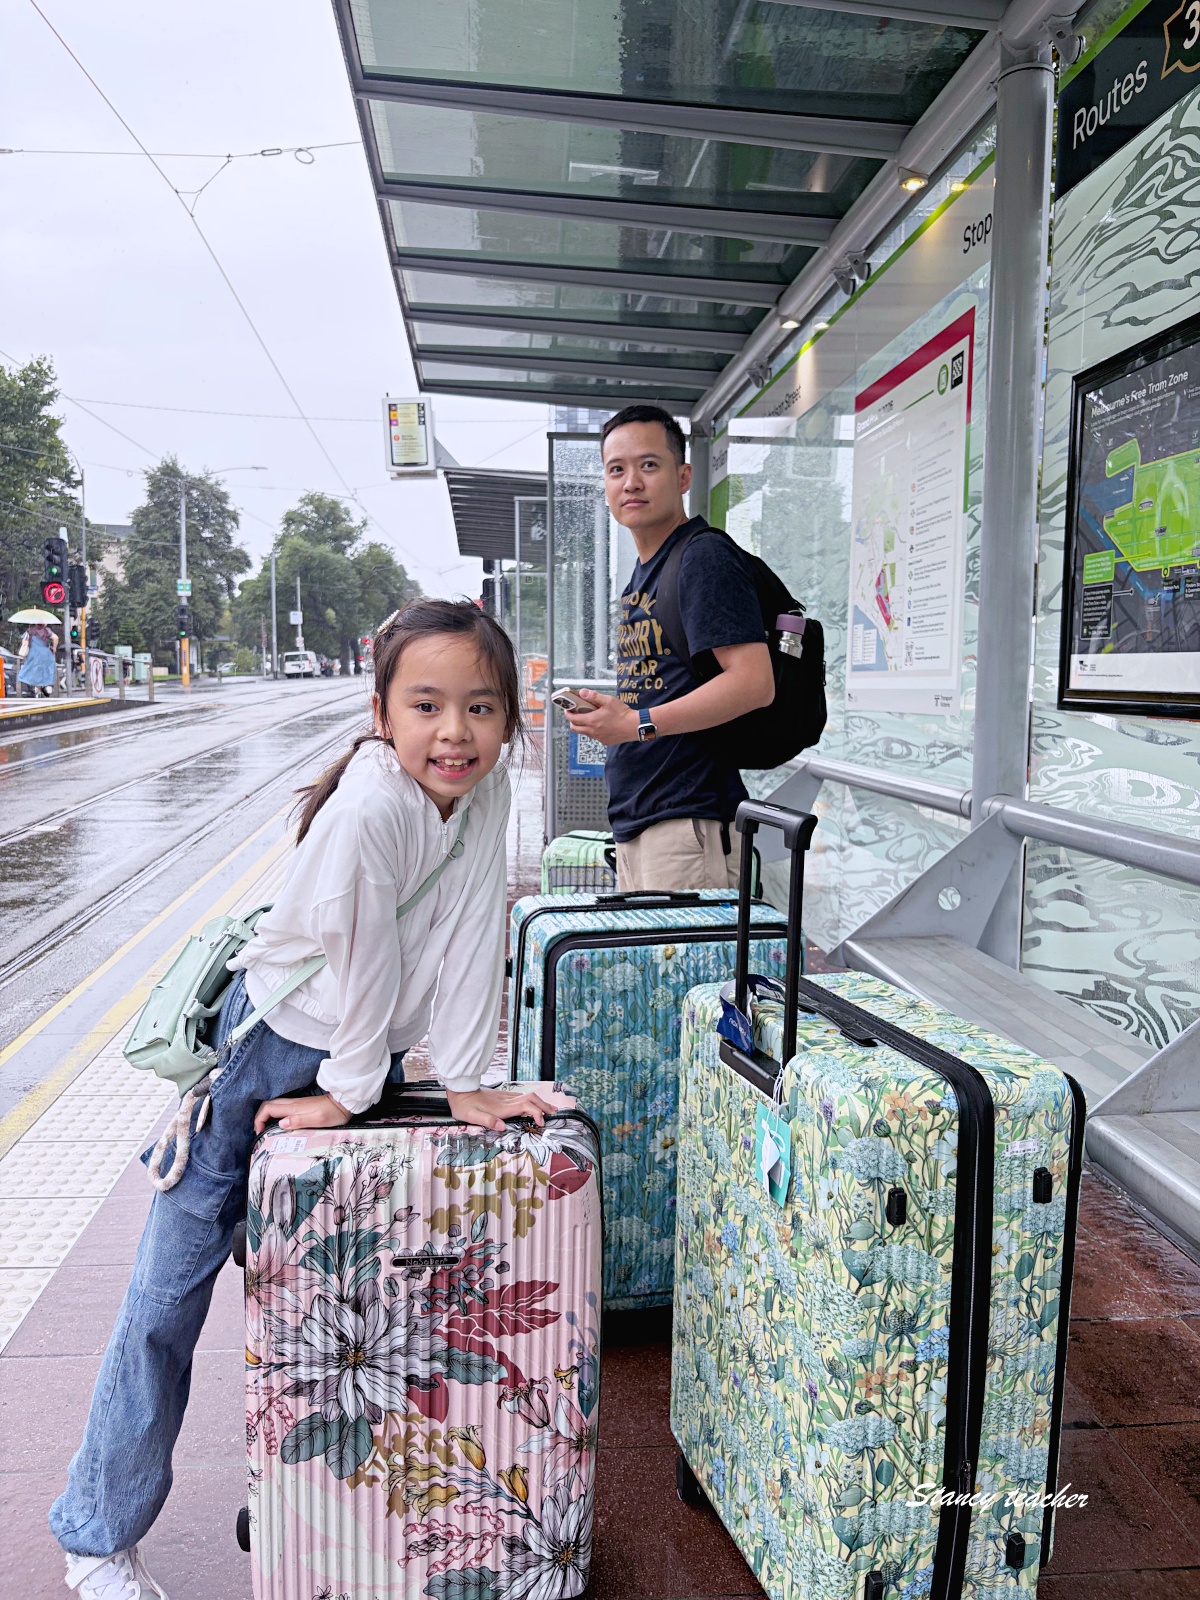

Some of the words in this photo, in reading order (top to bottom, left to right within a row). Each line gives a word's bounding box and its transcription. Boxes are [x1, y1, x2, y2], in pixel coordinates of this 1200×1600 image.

[1073, 60, 1148, 150] Routes
[963, 213, 992, 254] Stop
[1092, 394, 1130, 418] Melbourne's
[1130, 388, 1147, 402] Free
[1148, 379, 1167, 395] Tram
[1168, 371, 1189, 387] Zone
[644, 677, 668, 690] CO.
